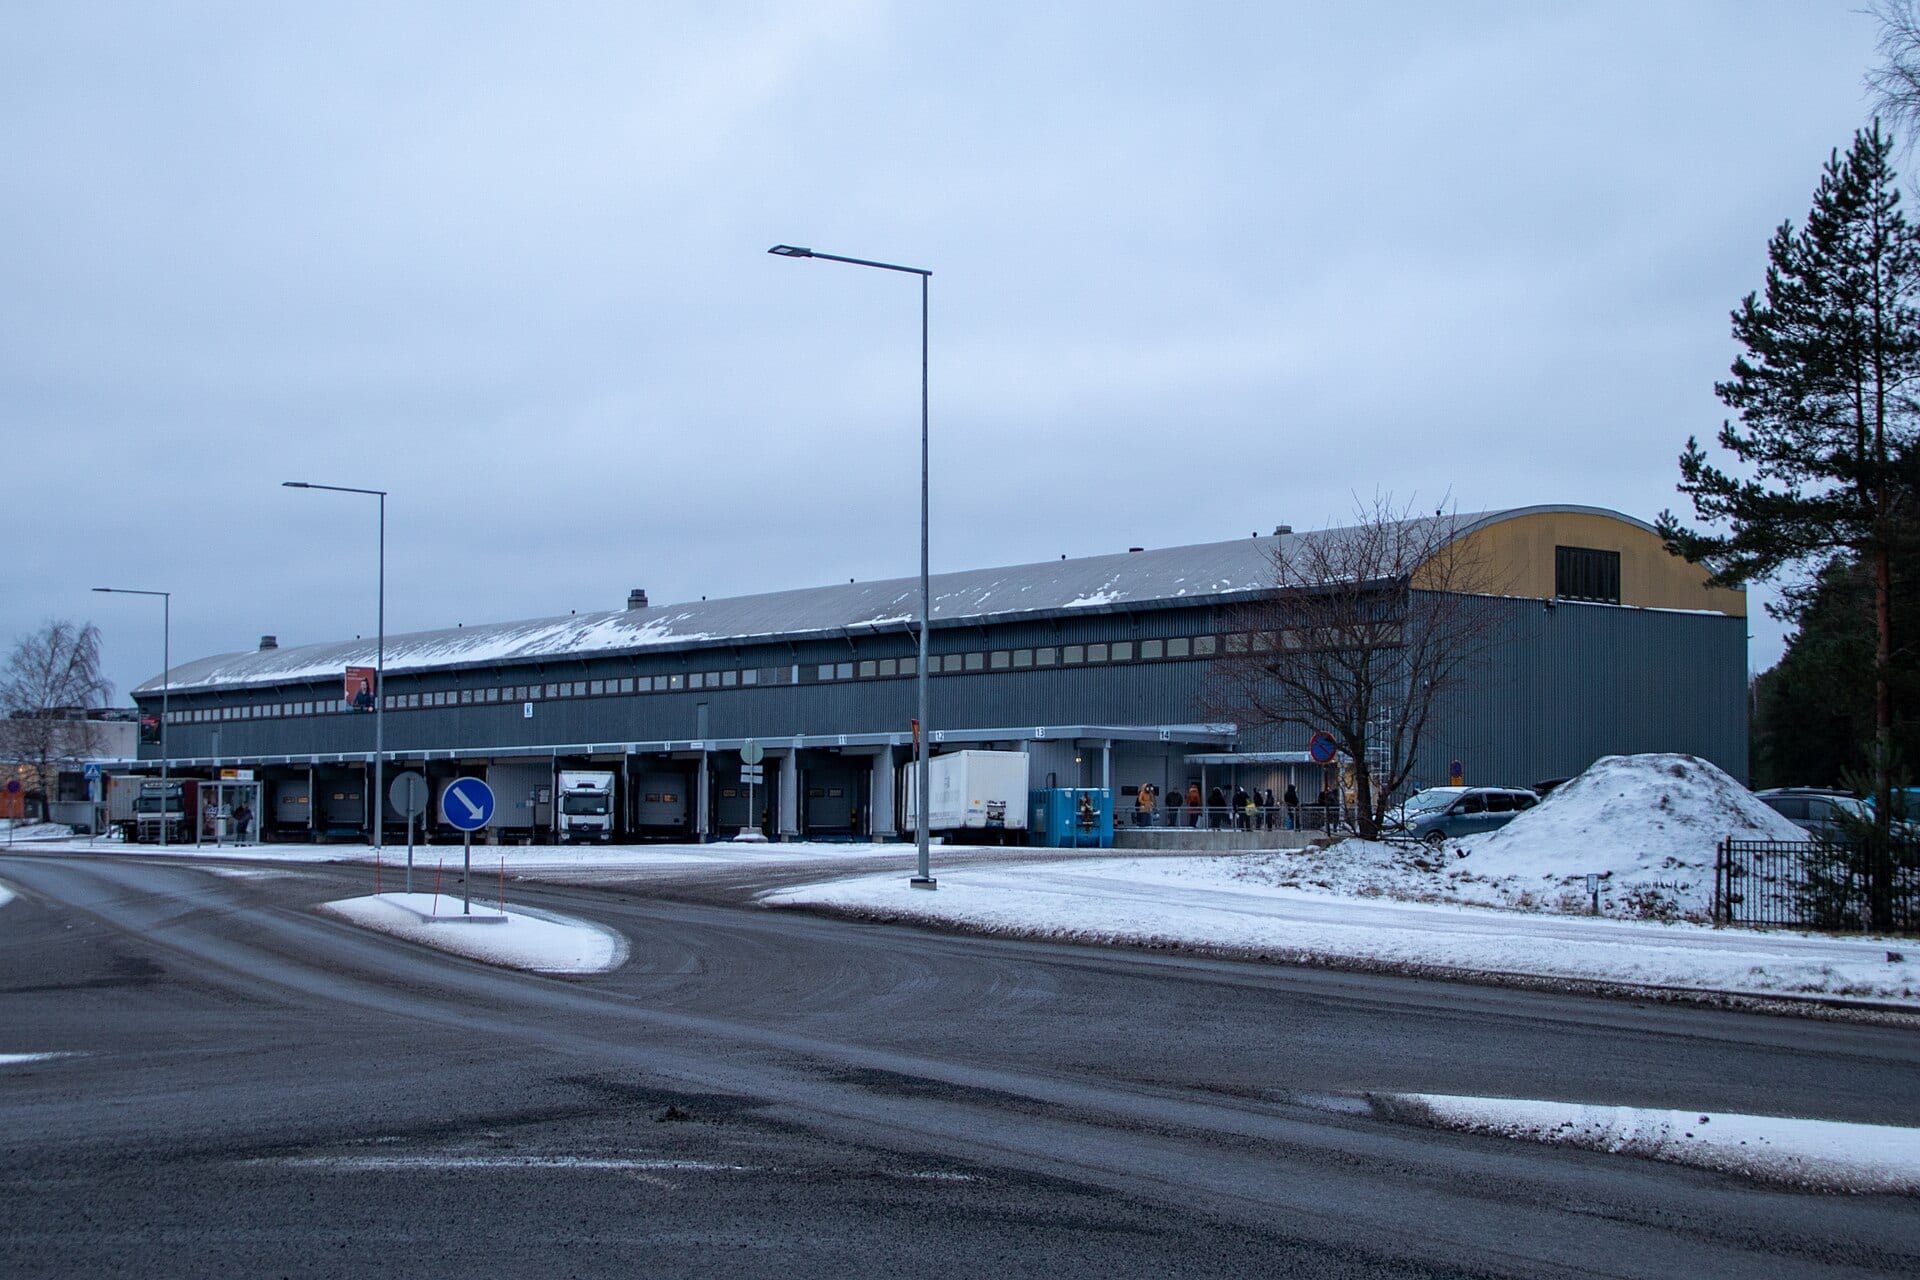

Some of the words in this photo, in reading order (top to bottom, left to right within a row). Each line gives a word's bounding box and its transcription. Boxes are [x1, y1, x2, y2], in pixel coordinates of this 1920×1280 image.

[936, 731, 944, 741] 12
[1036, 727, 1045, 737] 13
[1161, 730, 1169, 739] 14
